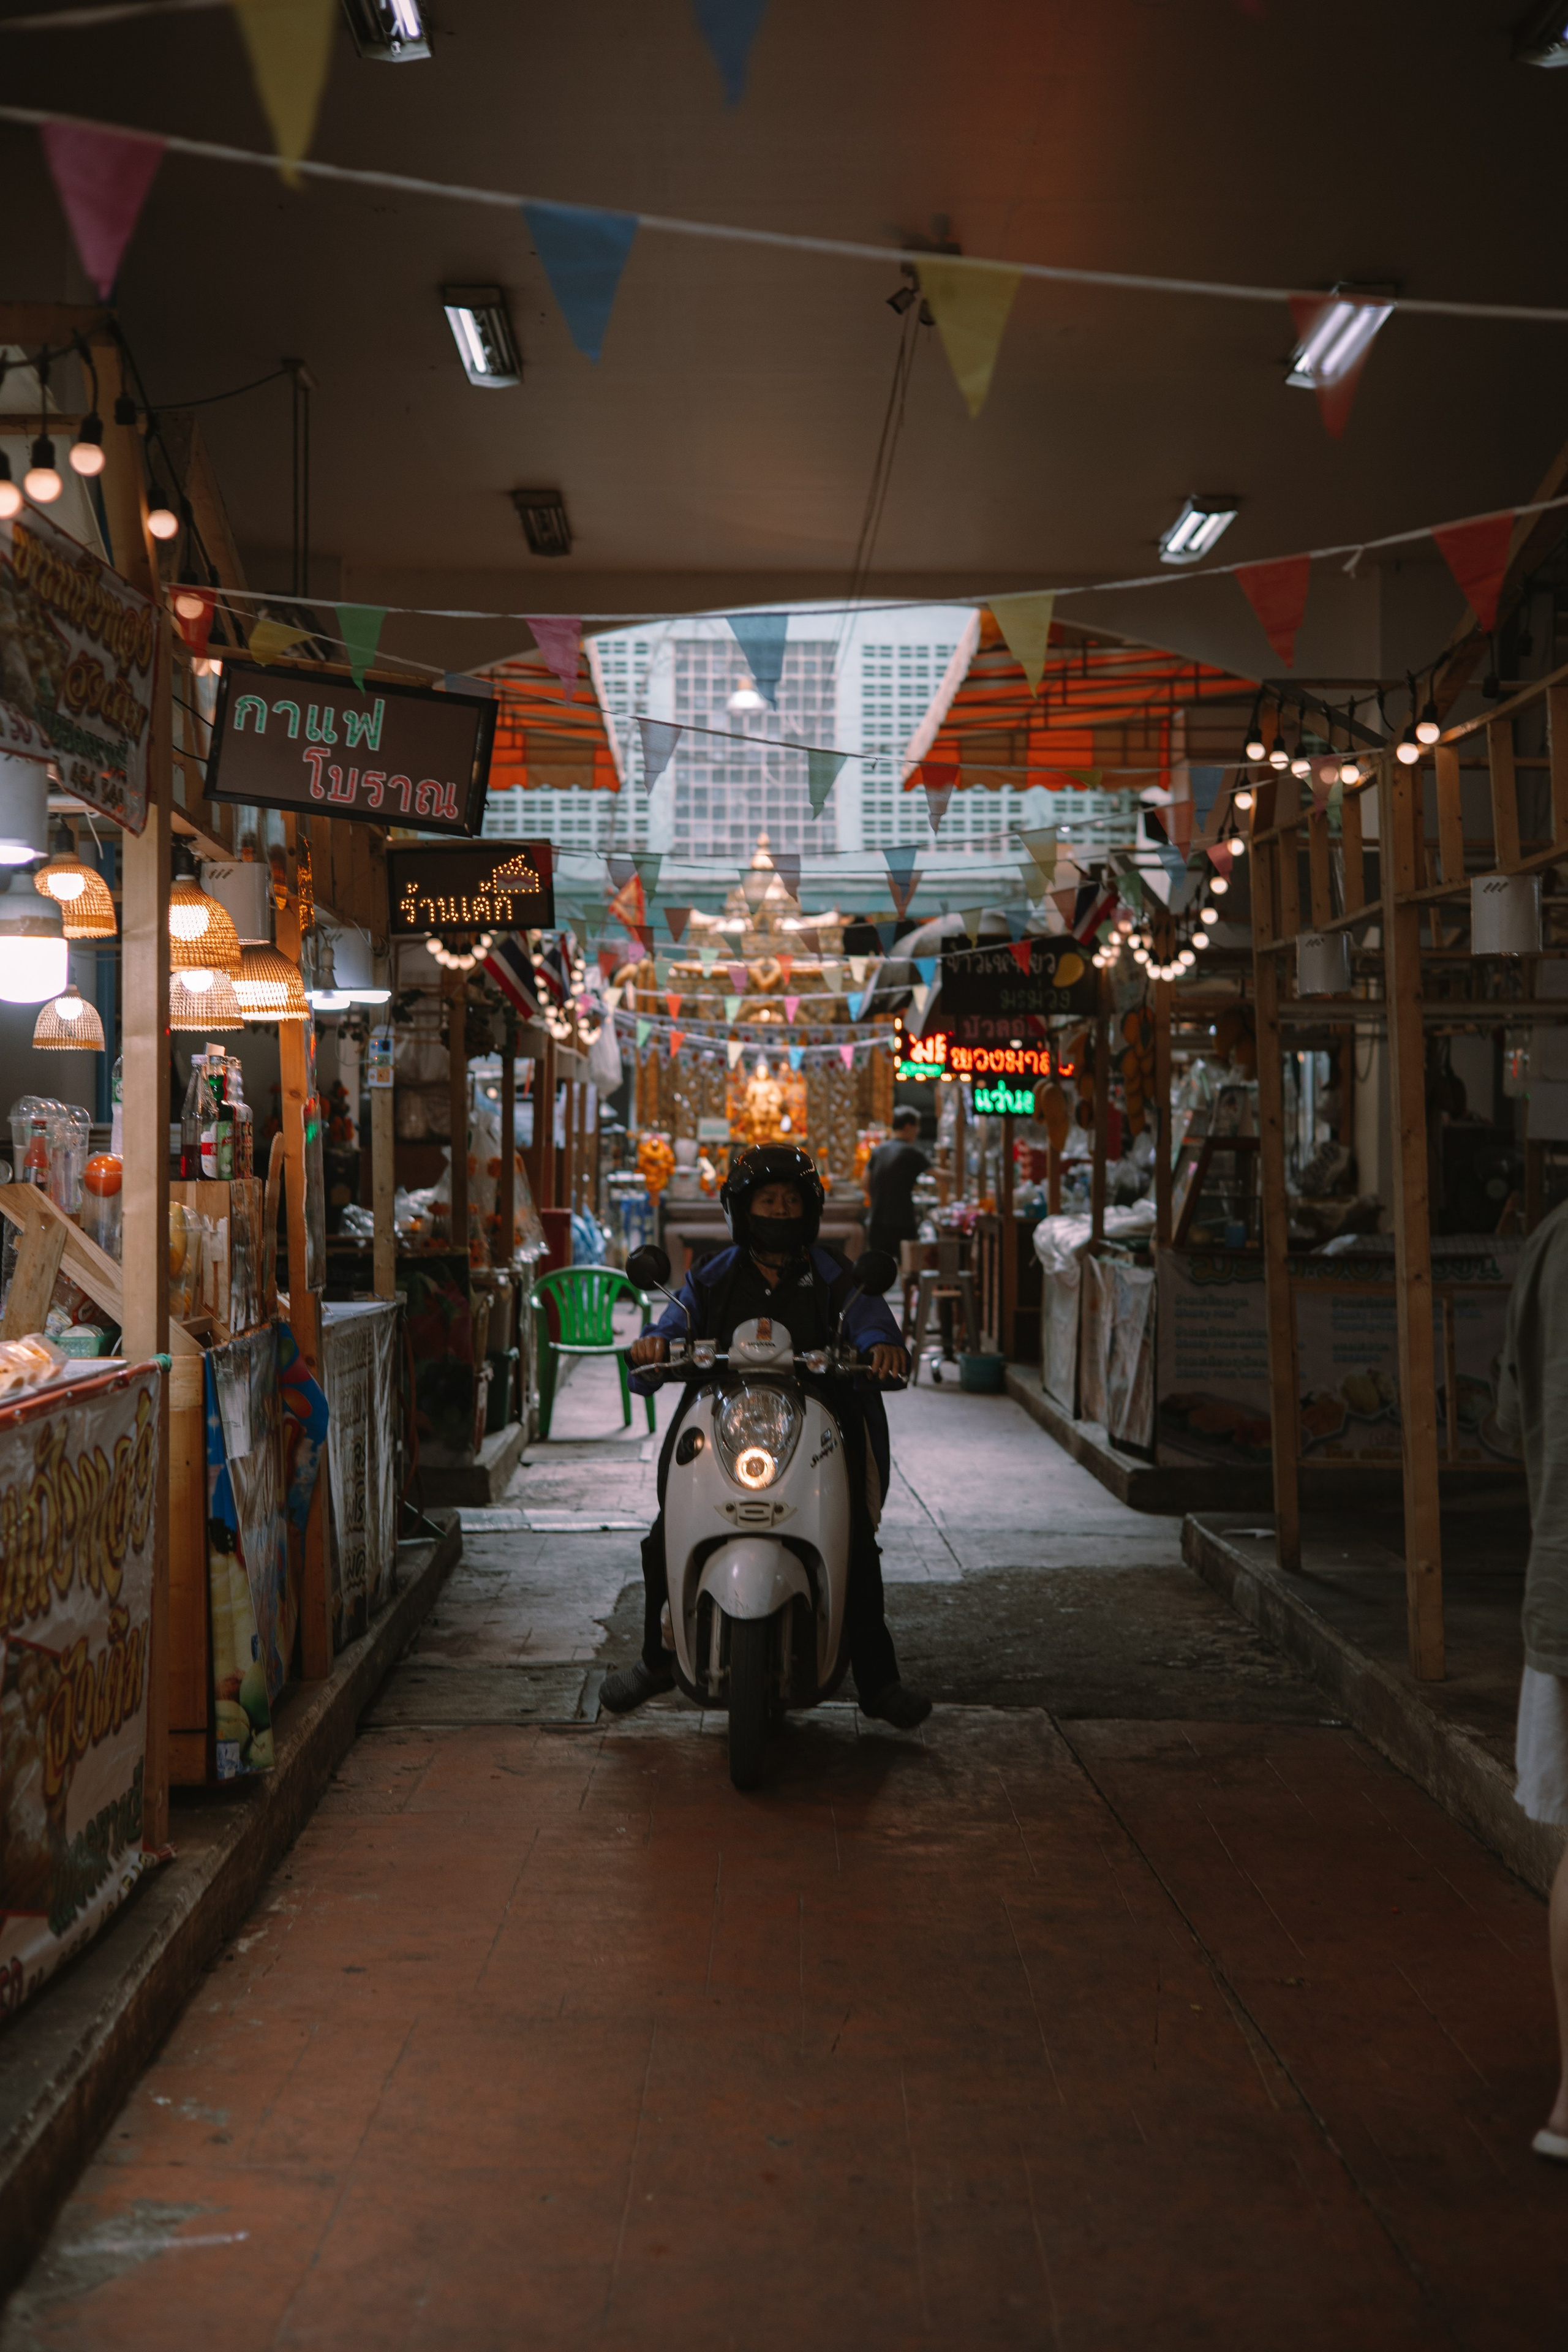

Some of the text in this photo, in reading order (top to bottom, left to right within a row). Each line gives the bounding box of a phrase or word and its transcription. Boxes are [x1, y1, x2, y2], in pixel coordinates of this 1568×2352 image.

[233, 694, 385, 751] กาแฟ
[302, 746, 459, 820] โบราณ
[399, 880, 513, 924] ร้านเค้ก
